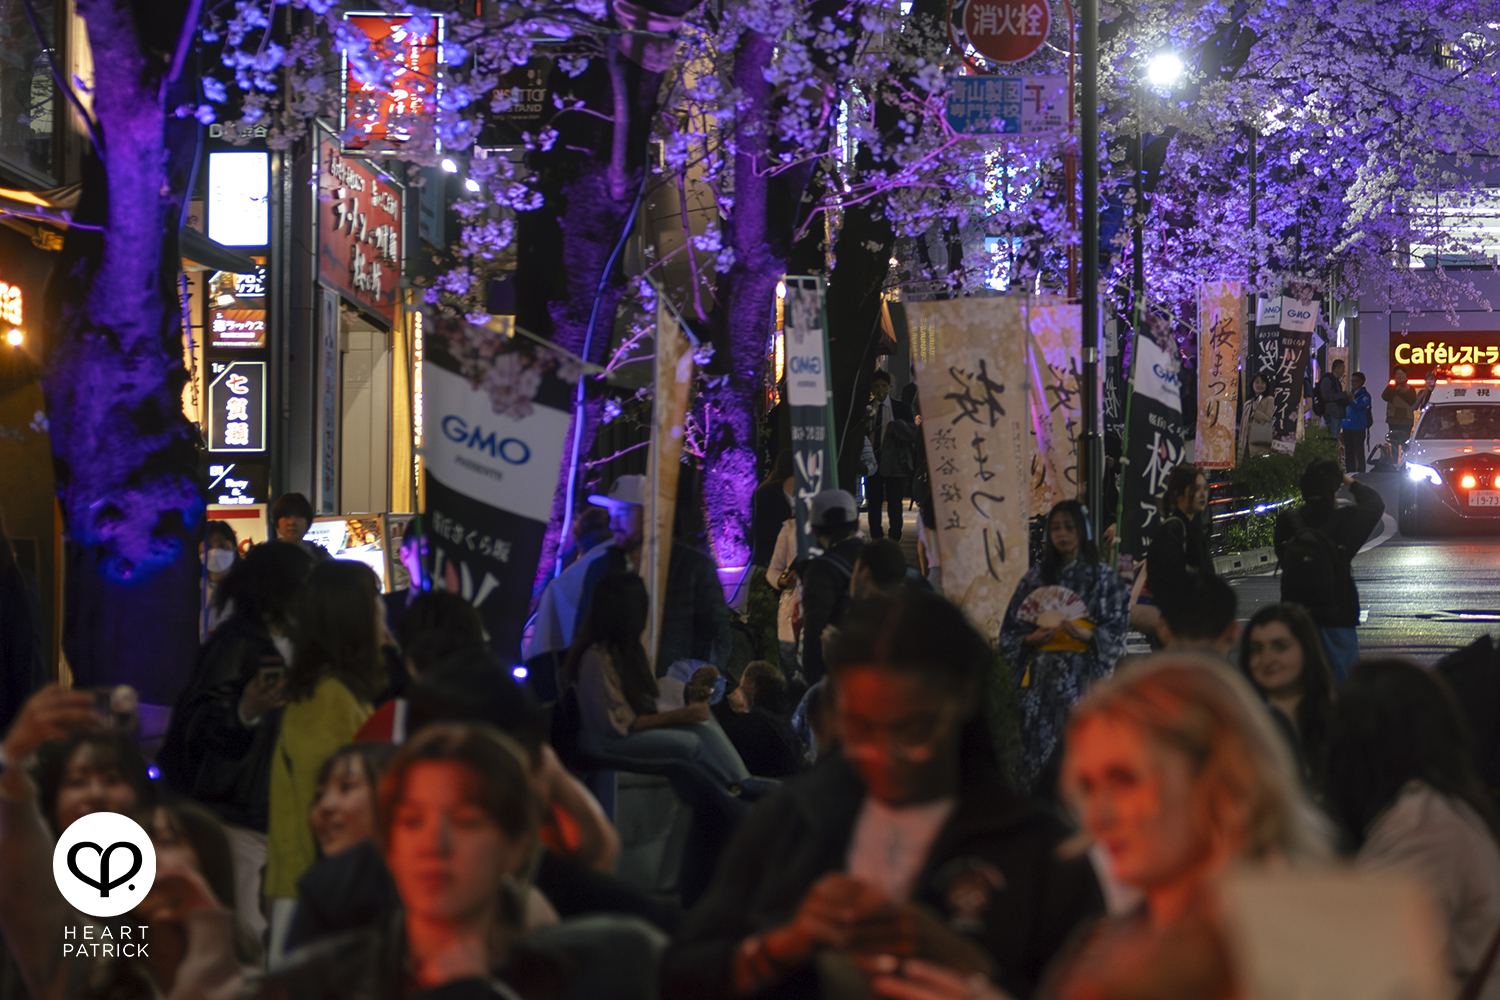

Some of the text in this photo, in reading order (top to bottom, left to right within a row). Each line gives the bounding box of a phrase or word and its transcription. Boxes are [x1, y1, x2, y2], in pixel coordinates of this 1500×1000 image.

[972, 3, 1044, 36] 消火栓
[1206, 313, 1237, 429] 桜まつり
[441, 414, 532, 466] GMO
